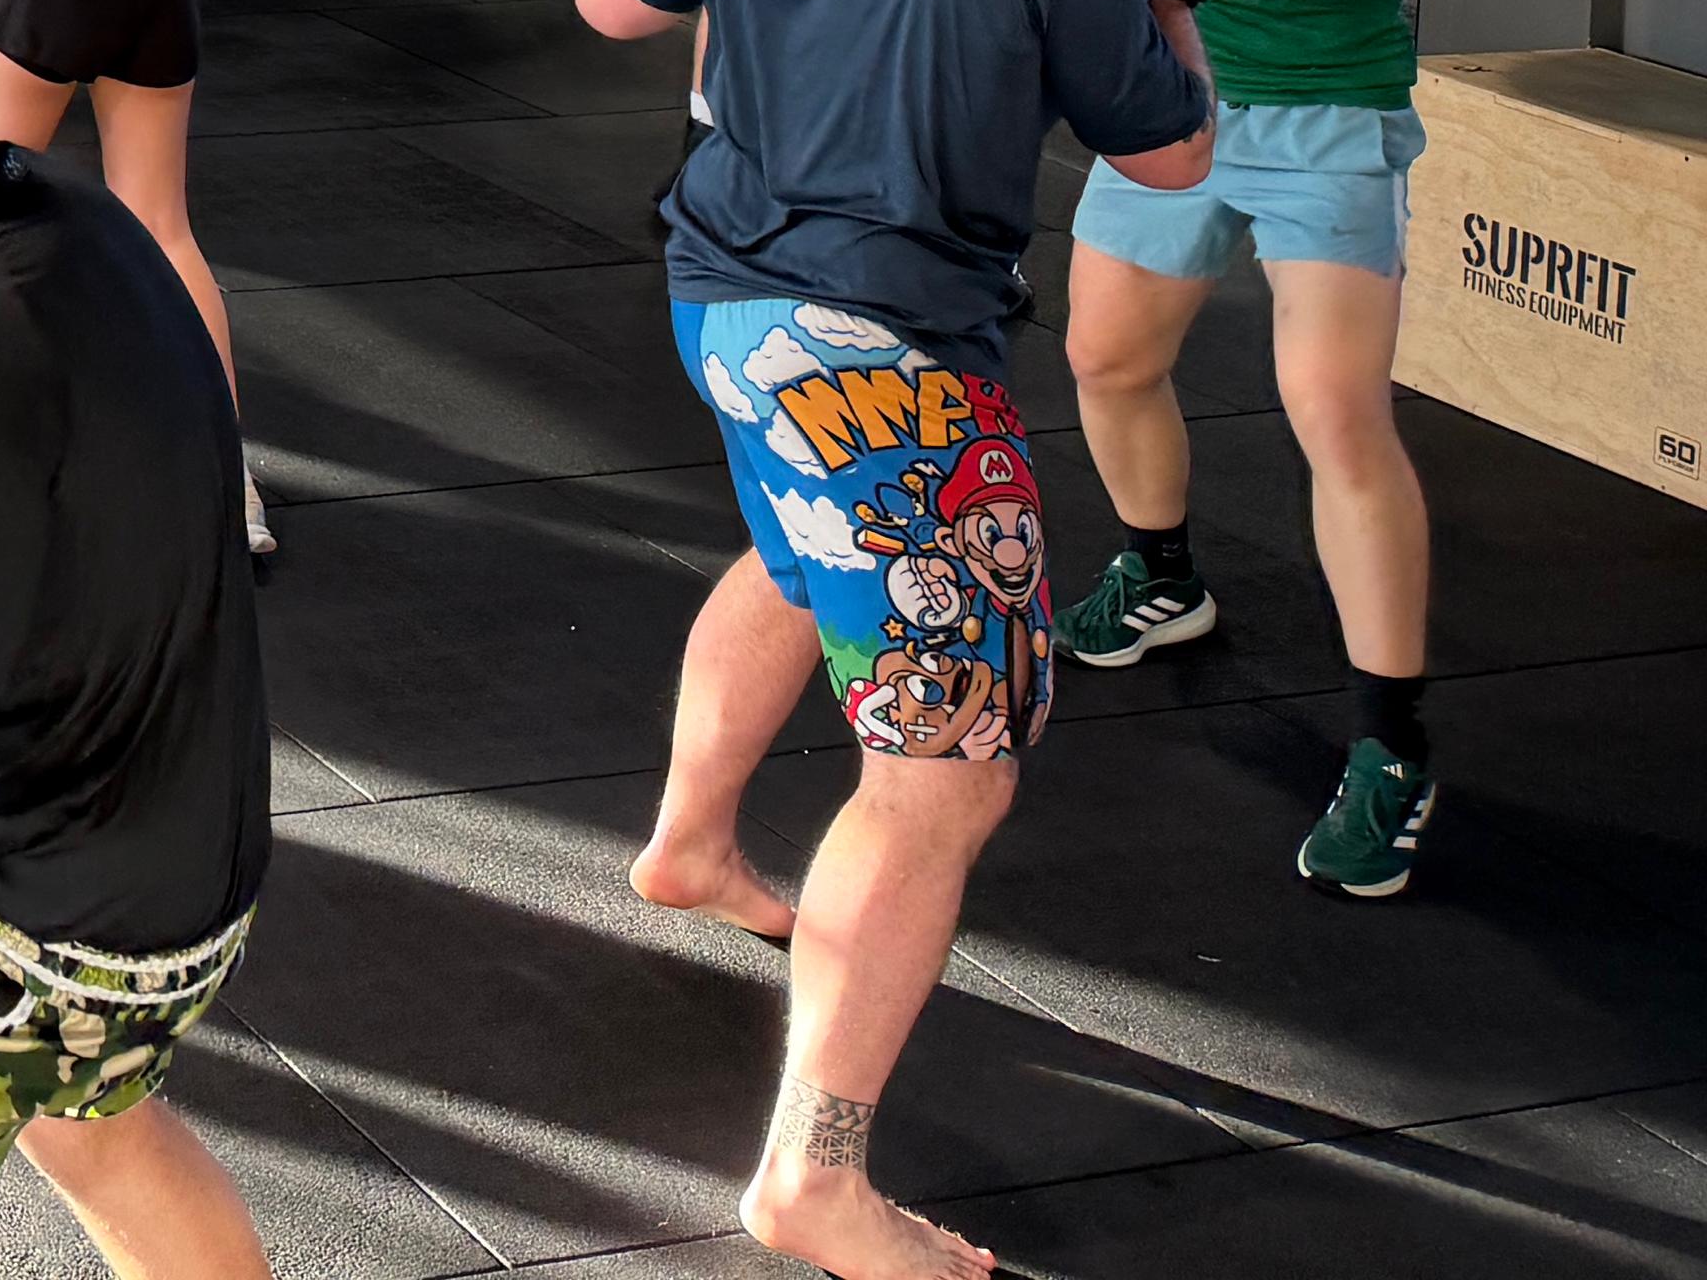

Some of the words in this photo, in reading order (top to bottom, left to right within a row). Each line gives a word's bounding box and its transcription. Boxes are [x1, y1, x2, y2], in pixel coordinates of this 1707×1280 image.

[1461, 212, 1637, 320] SUPRFIT
[1462, 266, 1526, 308] FITNESS
[1528, 290, 1627, 345] EQUIPMENT
[1658, 433, 1696, 466] 60
